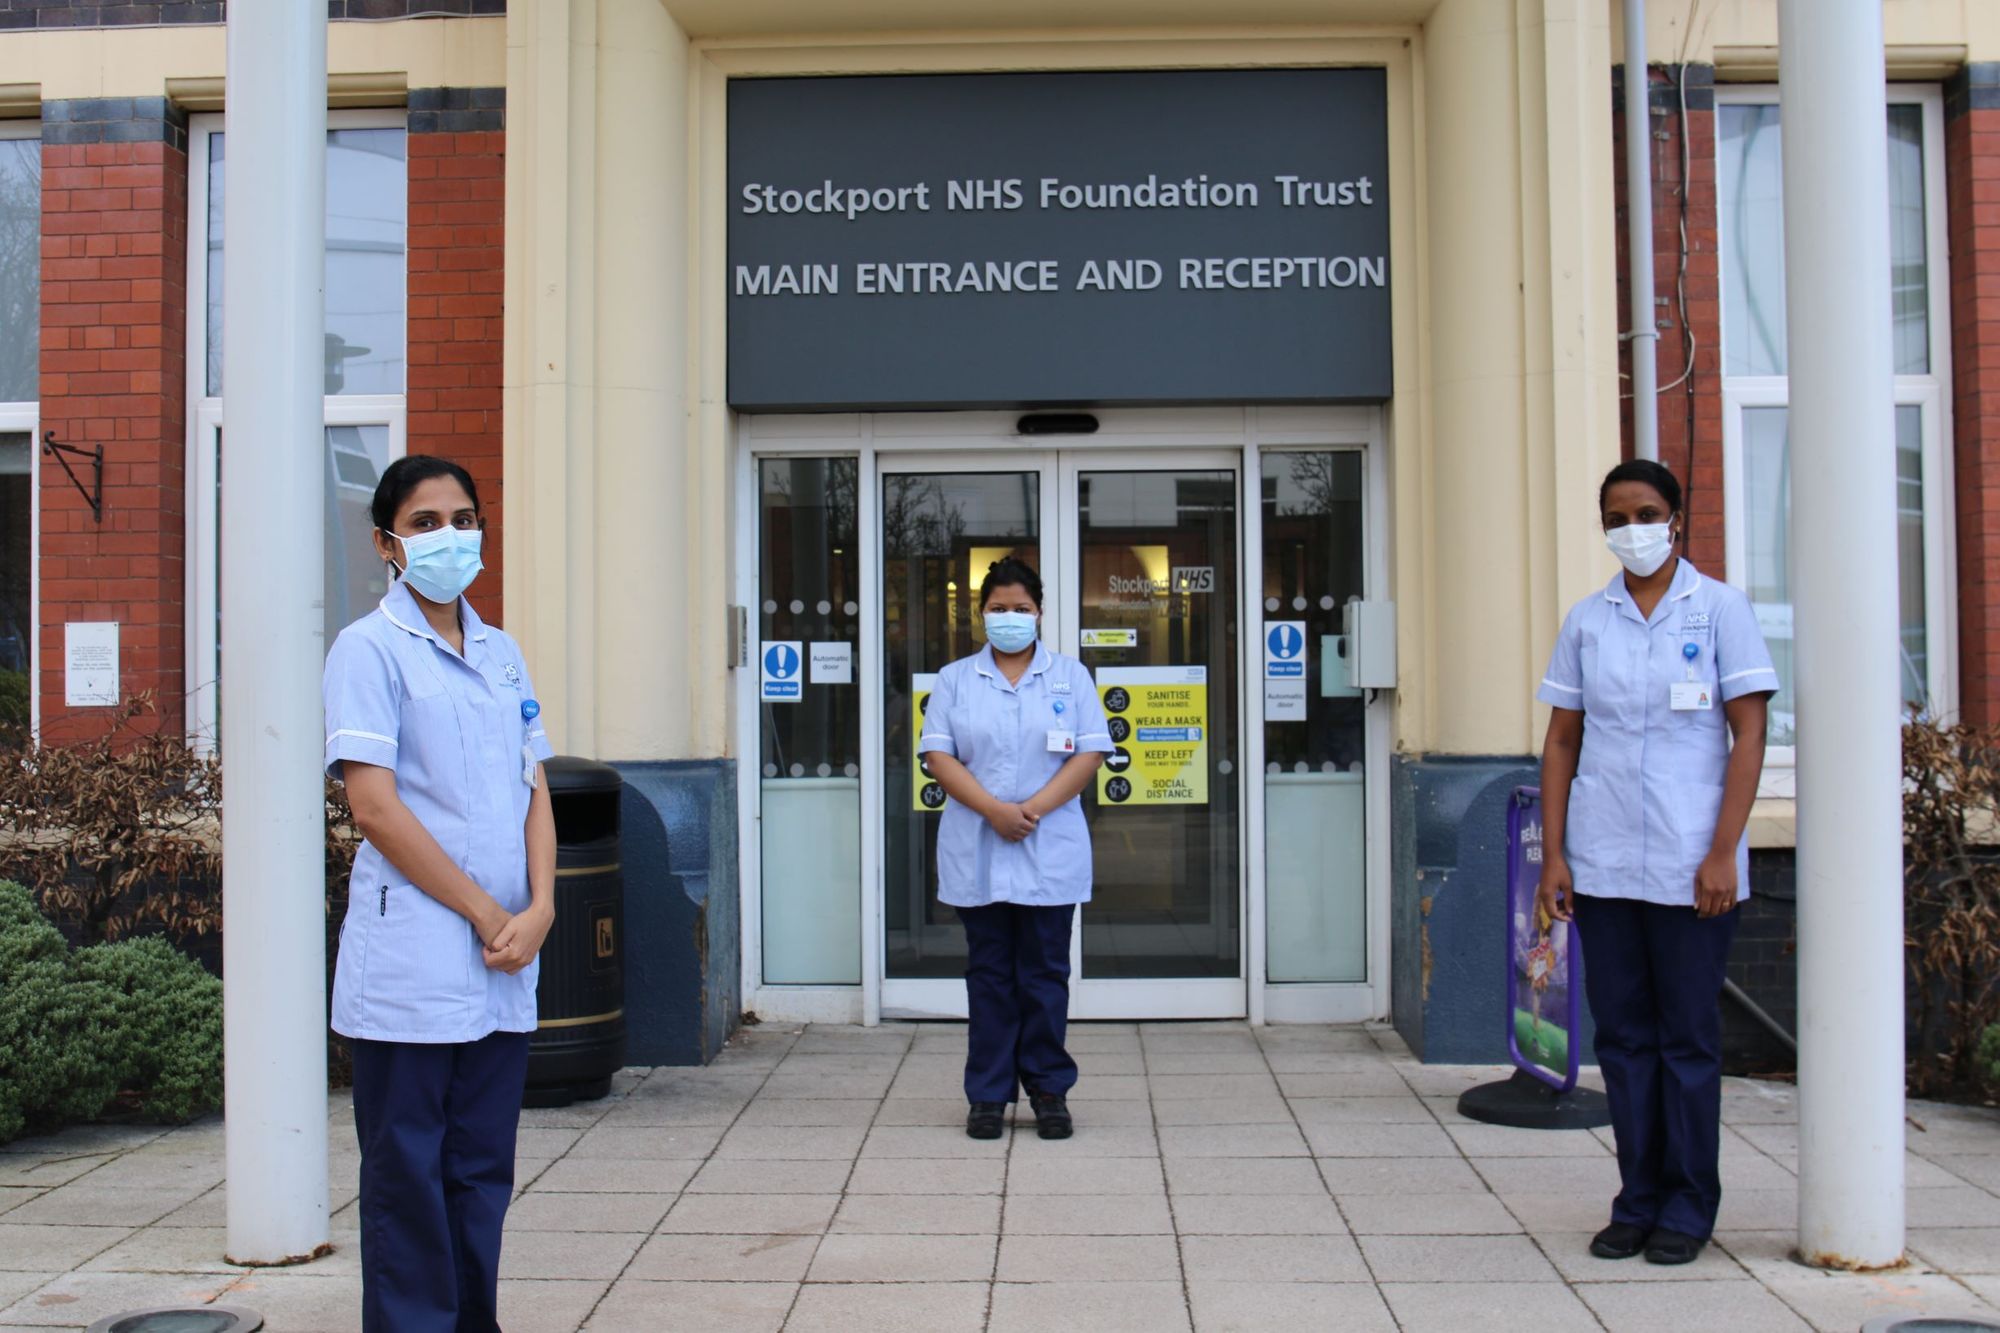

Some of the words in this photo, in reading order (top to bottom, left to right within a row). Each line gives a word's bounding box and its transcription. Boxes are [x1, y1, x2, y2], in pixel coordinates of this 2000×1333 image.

[742, 179, 930, 220] Stockport
[947, 178, 1024, 211] NHS
[1040, 174, 1258, 210] Foundation
[1274, 175, 1373, 207] Trust
[735, 264, 839, 295] MAIN
[856, 260, 1059, 293] ENTRANCE
[1075, 259, 1163, 291] AND
[1179, 256, 1386, 289] RECEPTION
[1109, 575, 1169, 598] Stockport
[1174, 569, 1212, 590] NHS
[1686, 612, 1710, 624] NHS
[1269, 665, 1285, 673] Keep
[765, 685, 781, 693] Keep
[1146, 690, 1191, 701] SANITISE
[1135, 716, 1162, 726] WEAR
[1165, 716, 1172, 725] A
[1174, 716, 1202, 725] MASK
[1145, 749, 1169, 760] KEEP
[1171, 749, 1194, 760] LEFT
[1152, 779, 1187, 789] SOCIAL
[1146, 788, 1194, 799] DISTANCE
